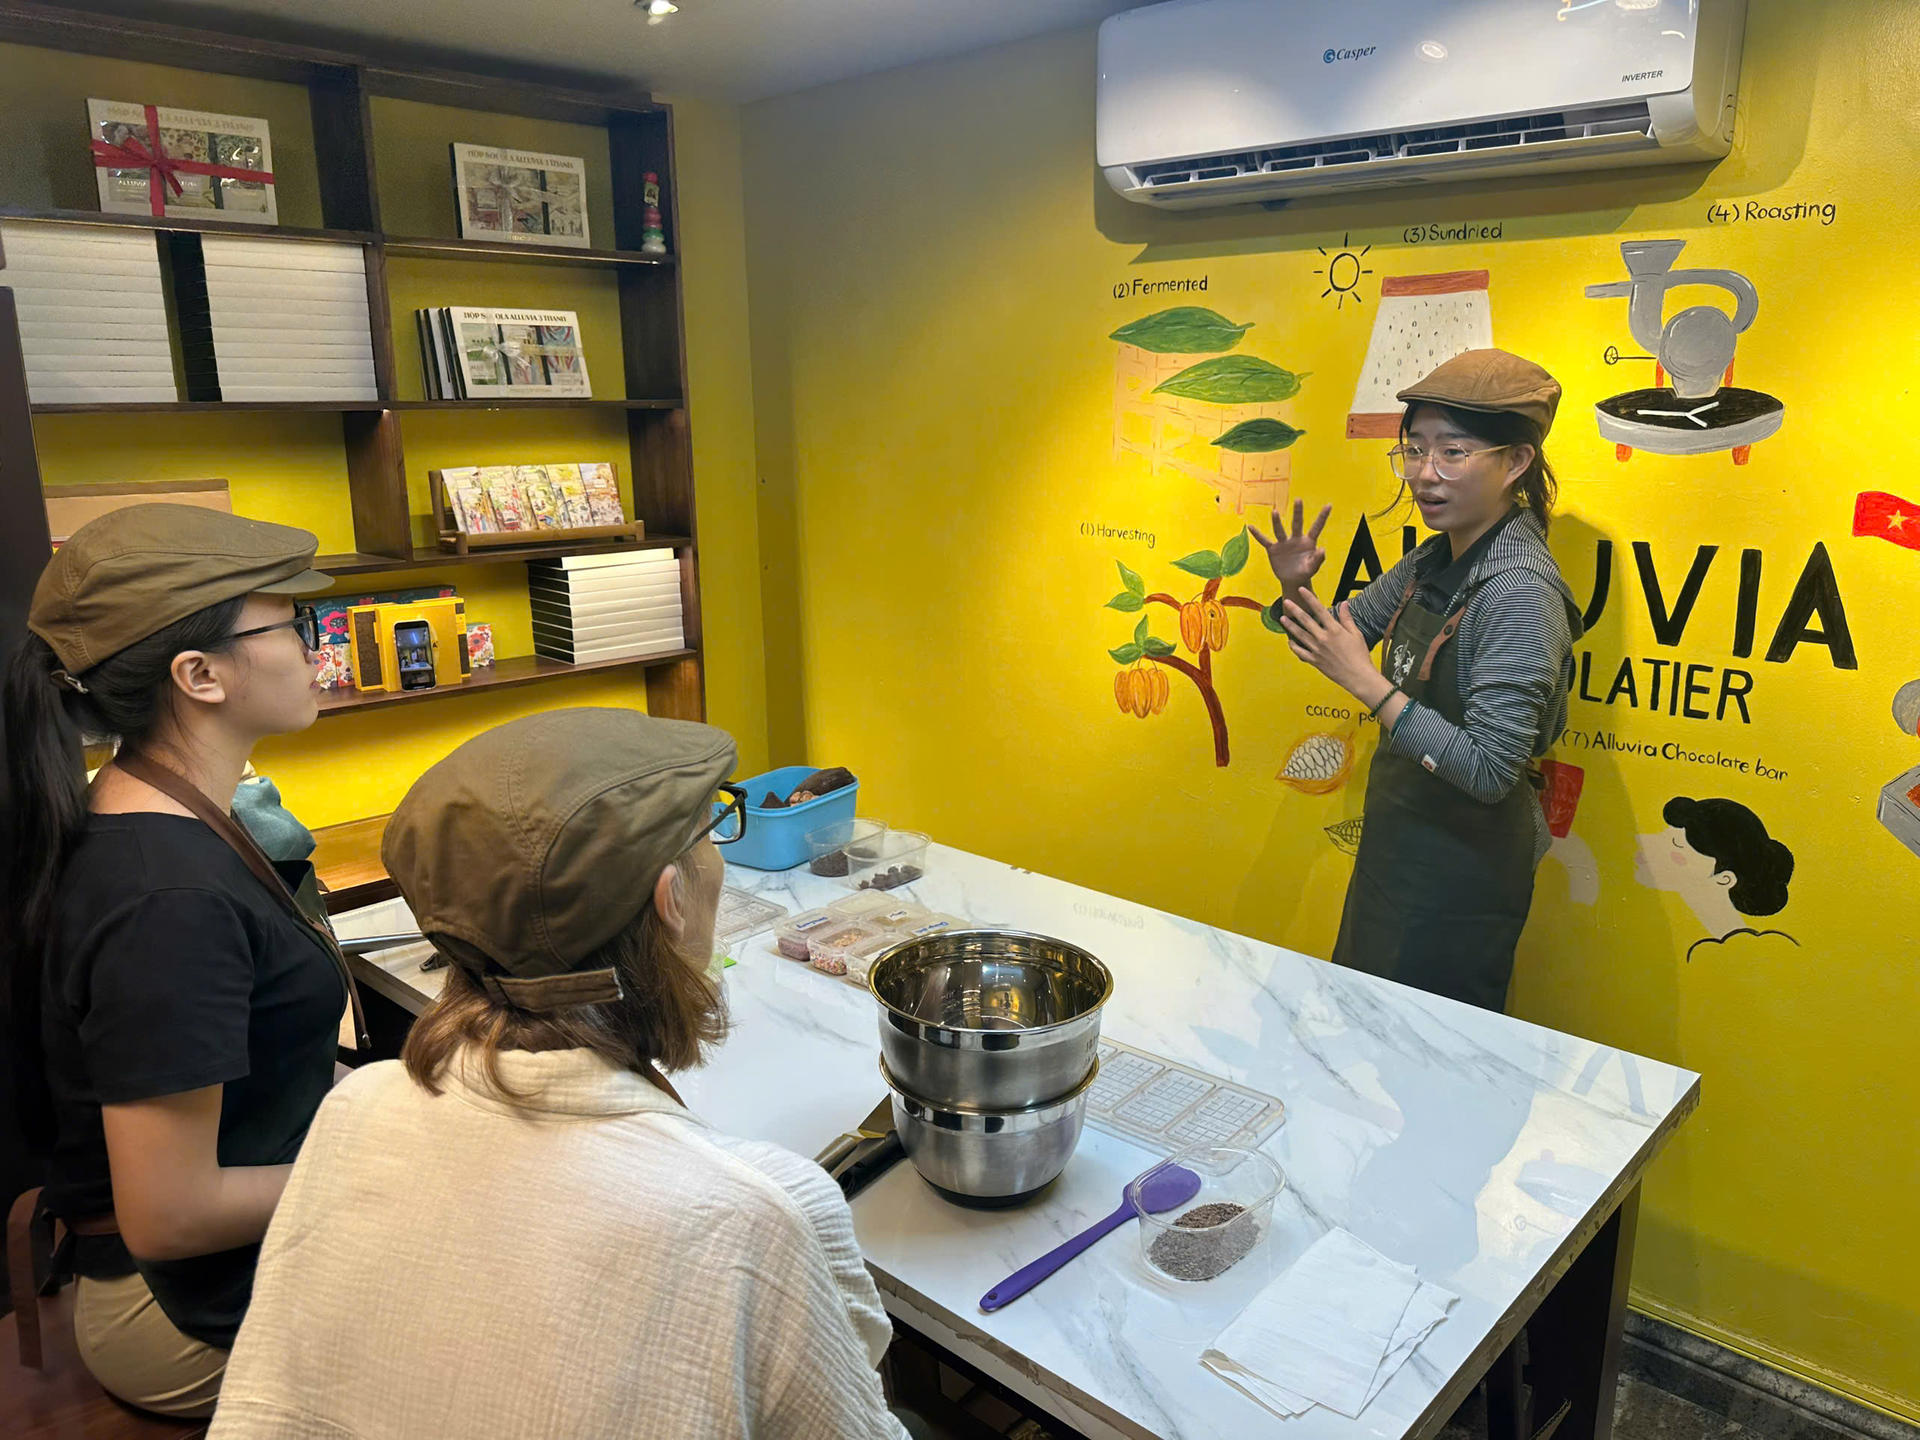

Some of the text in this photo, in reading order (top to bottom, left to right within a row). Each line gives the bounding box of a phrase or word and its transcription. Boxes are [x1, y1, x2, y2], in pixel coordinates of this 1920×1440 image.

[1336, 46, 1376, 61] Casper
[1621, 69, 1664, 83] INVERTER
[1745, 201, 1836, 226] Roasting
[1429, 222, 1503, 240] Sundried
[1132, 275, 1208, 296] Fermented
[1097, 523, 1156, 549] Harvesting
[1332, 513, 1858, 670] AUVIA
[1568, 650, 1754, 724] LATIER
[1305, 704, 1351, 720] cacao
[1591, 730, 1658, 757] Alluvia
[1662, 742, 1750, 773] Chocolate
[1755, 758, 1789, 782] bar
